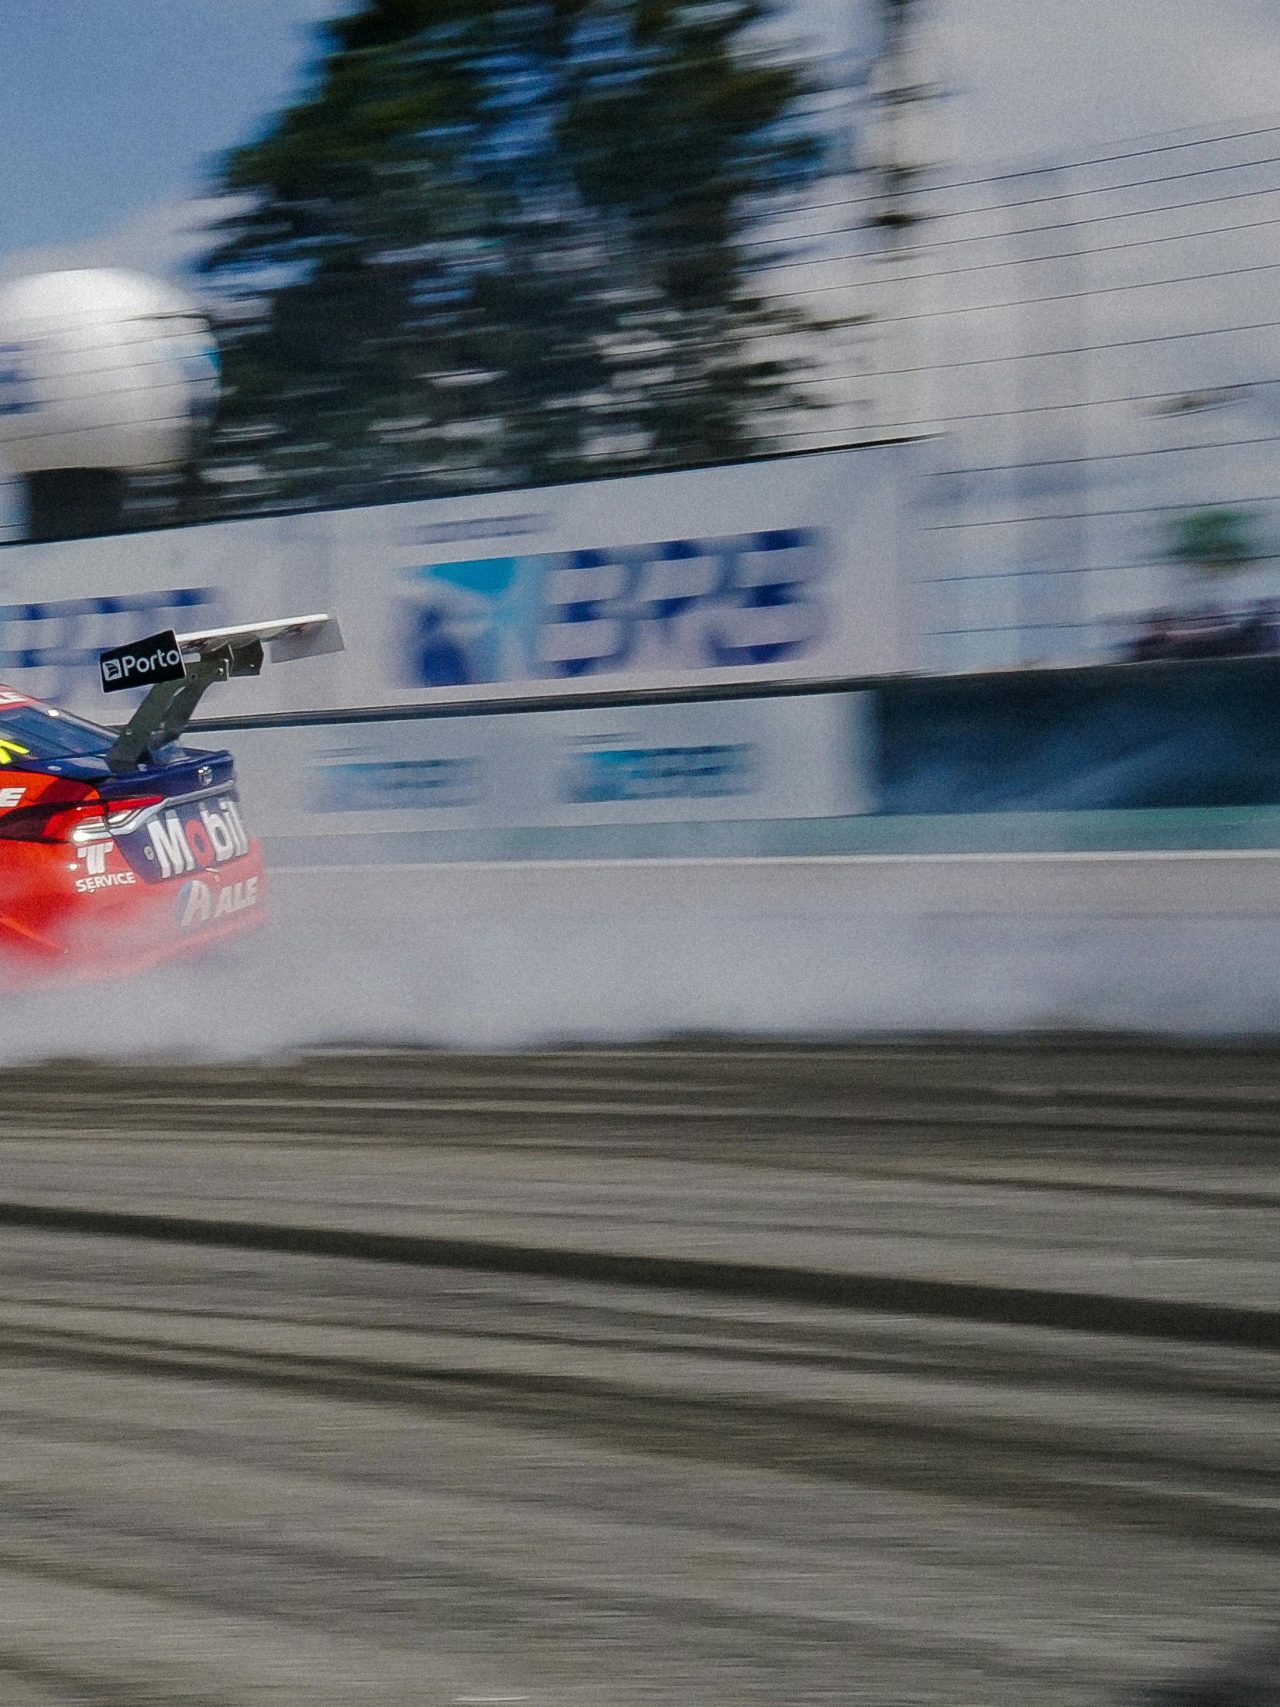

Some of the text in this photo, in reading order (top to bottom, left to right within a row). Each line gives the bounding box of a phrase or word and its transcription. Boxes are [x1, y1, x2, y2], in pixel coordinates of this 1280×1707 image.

[121, 649, 180, 677] Porto
[146, 796, 250, 879] Mobil
[75, 871, 136, 893] SERVICE
[213, 876, 259, 919] ALE
